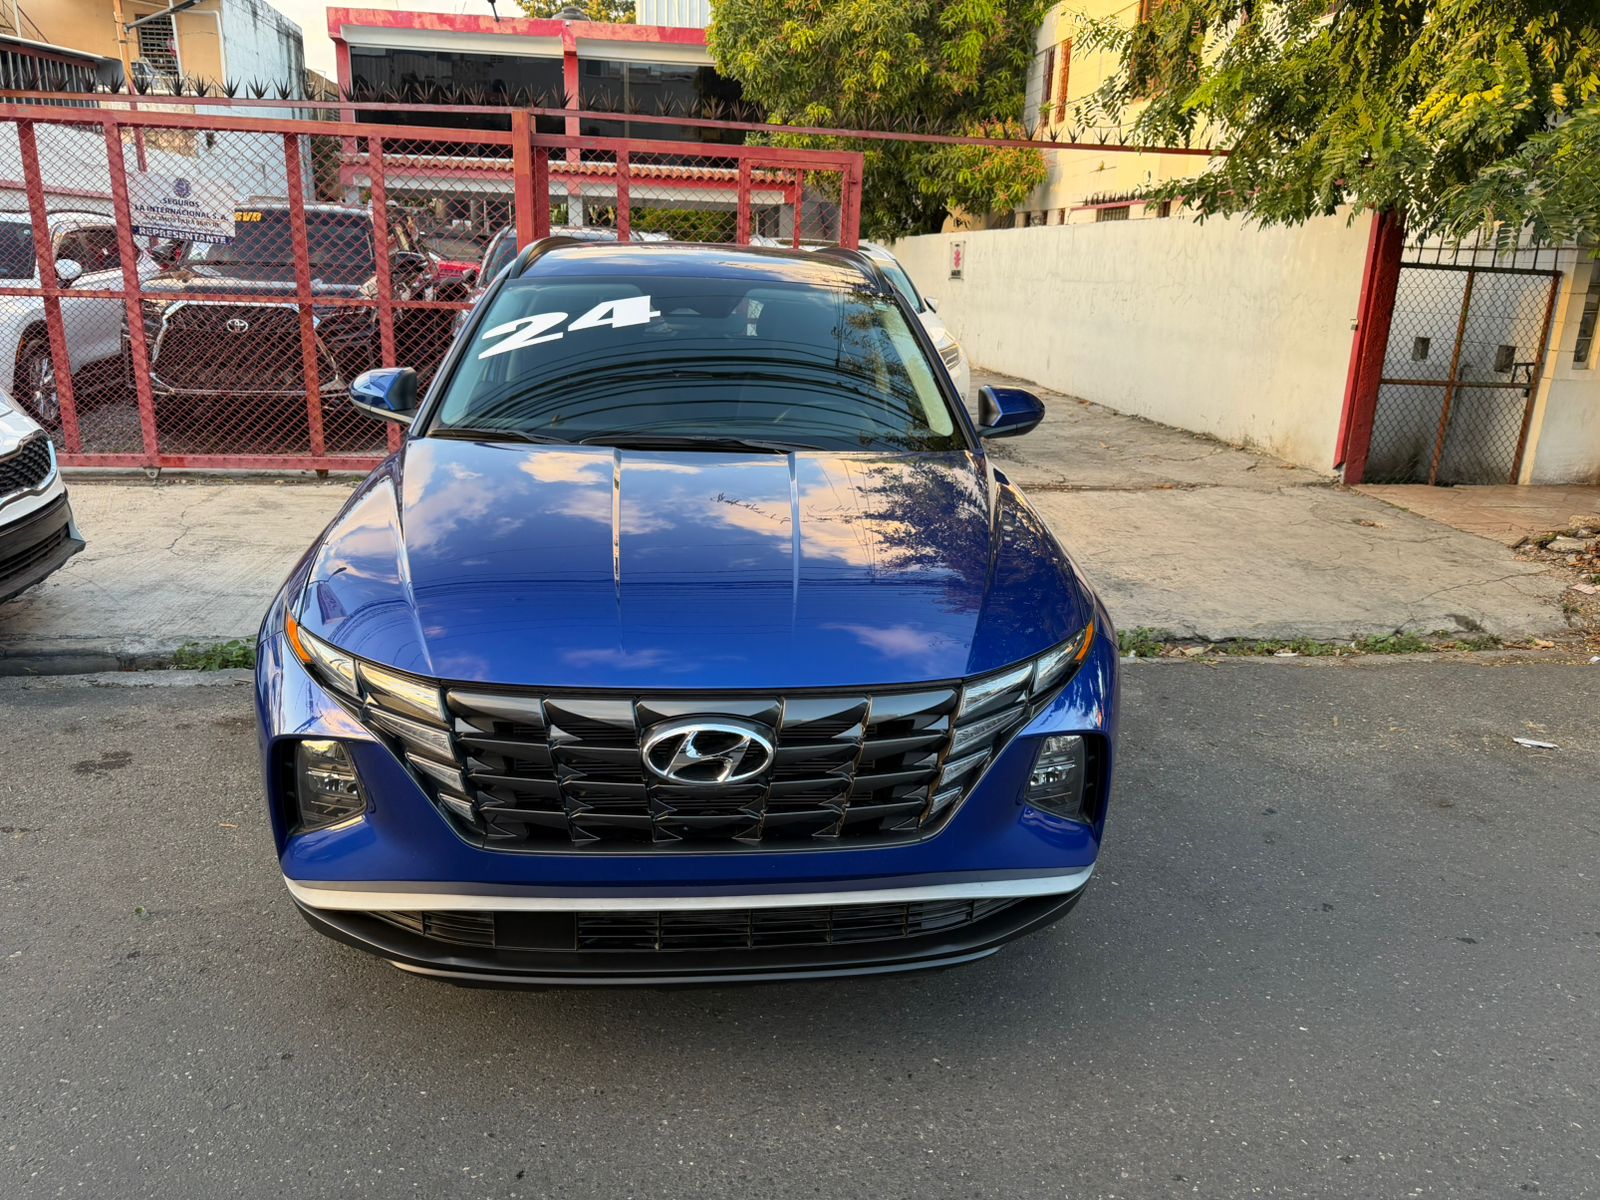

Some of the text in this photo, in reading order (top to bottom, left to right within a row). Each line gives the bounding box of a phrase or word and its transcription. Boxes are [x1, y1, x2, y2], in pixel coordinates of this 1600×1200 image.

[162, 198, 200, 208] SEGUROS
[134, 204, 146, 212] LA
[146, 205, 210, 218] INTERNACIONAL
[138, 227, 227, 244] REPRESENTANTE
[478, 295, 661, 360] 24
